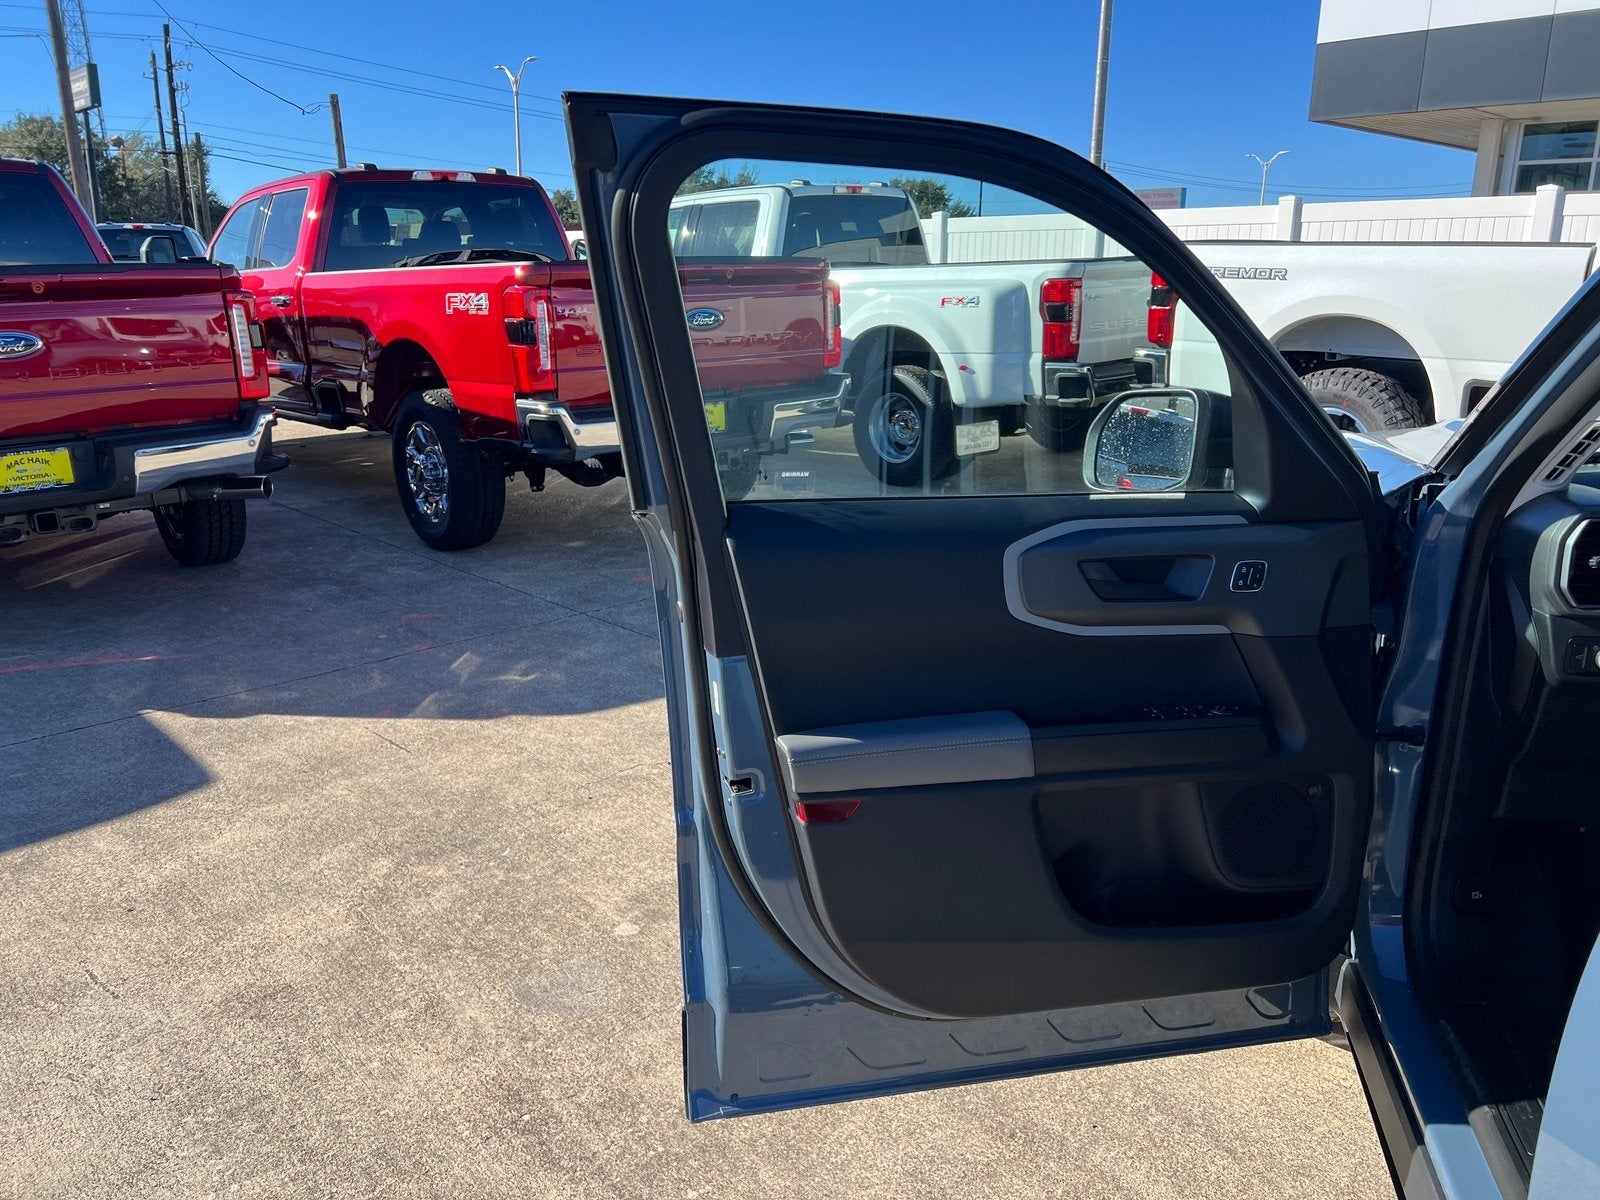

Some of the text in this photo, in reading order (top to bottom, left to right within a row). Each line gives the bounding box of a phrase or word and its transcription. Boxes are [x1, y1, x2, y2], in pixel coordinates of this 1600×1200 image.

[446, 292, 489, 314] FX4
[939, 296, 980, 308] FX4
[693, 313, 715, 325] Ford
[1089, 316, 1146, 332] SUPE
[6, 457, 51, 471] MAC HAIK
[12, 472, 50, 482] VICTORIA
